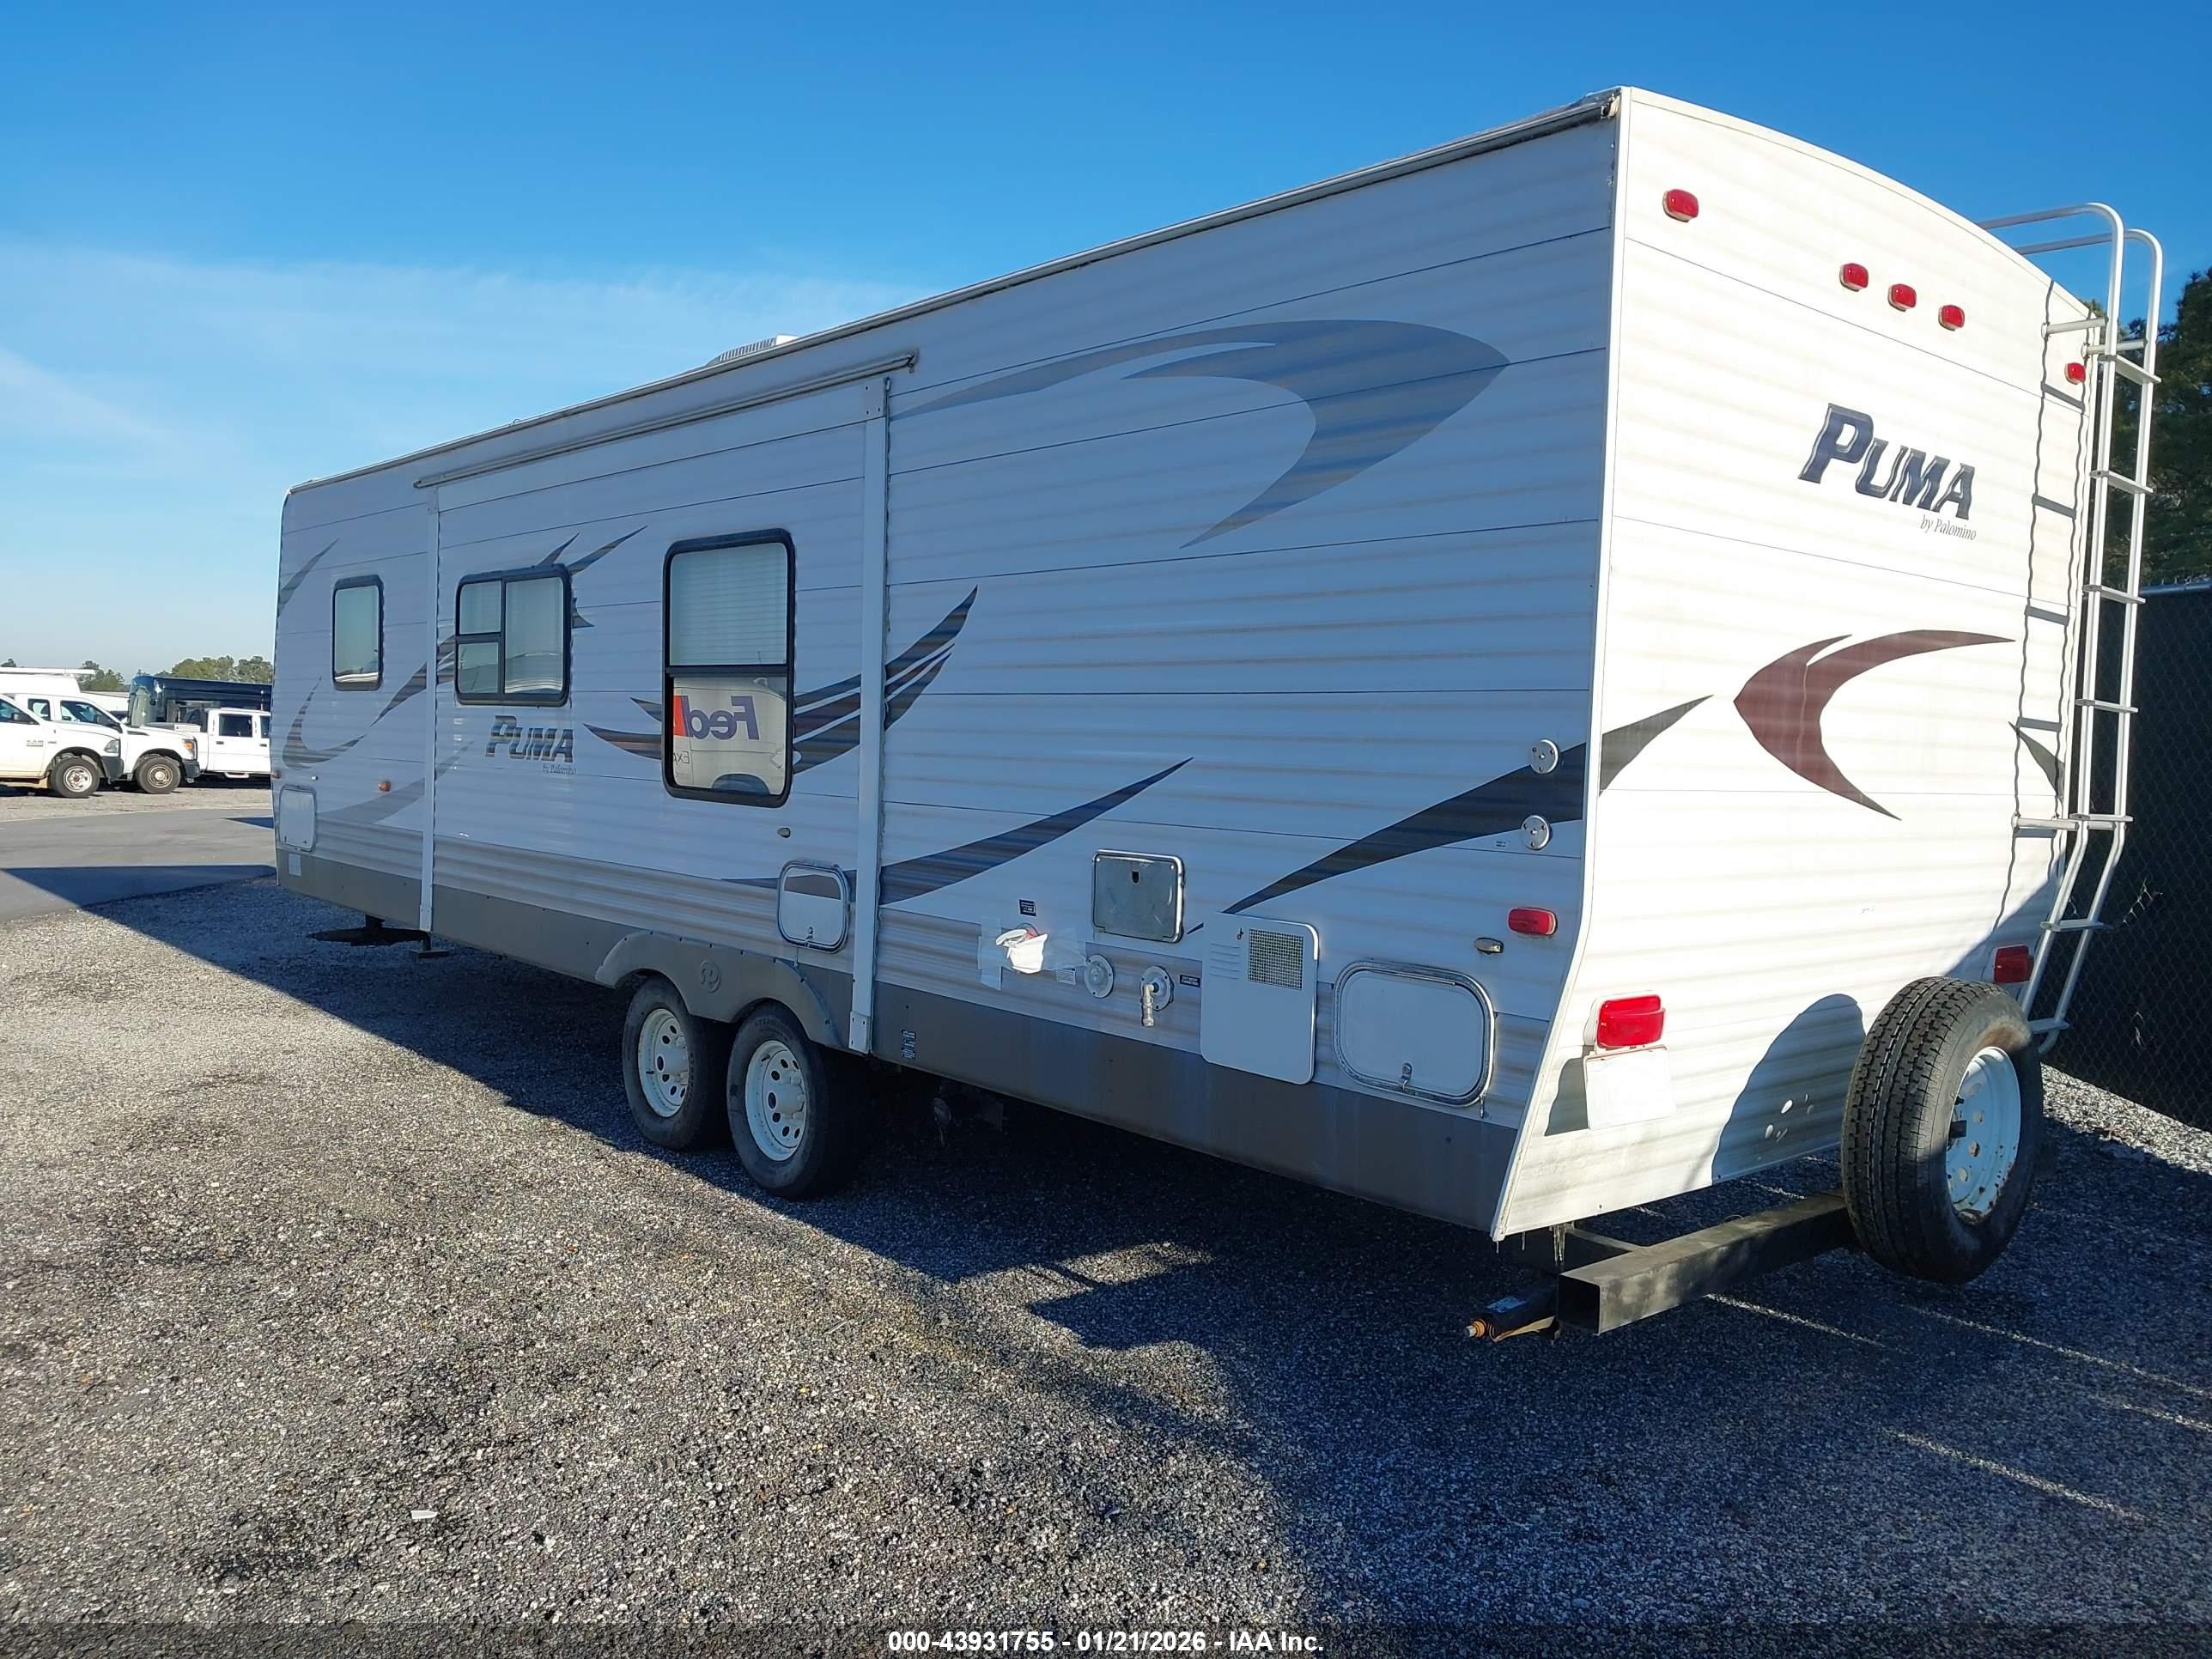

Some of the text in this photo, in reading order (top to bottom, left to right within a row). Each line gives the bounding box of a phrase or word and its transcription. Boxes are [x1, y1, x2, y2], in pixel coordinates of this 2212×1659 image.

[1797, 402, 1976, 520] PUMA
[1920, 514, 1977, 541] by Palomino
[485, 714, 574, 763] PUMA
